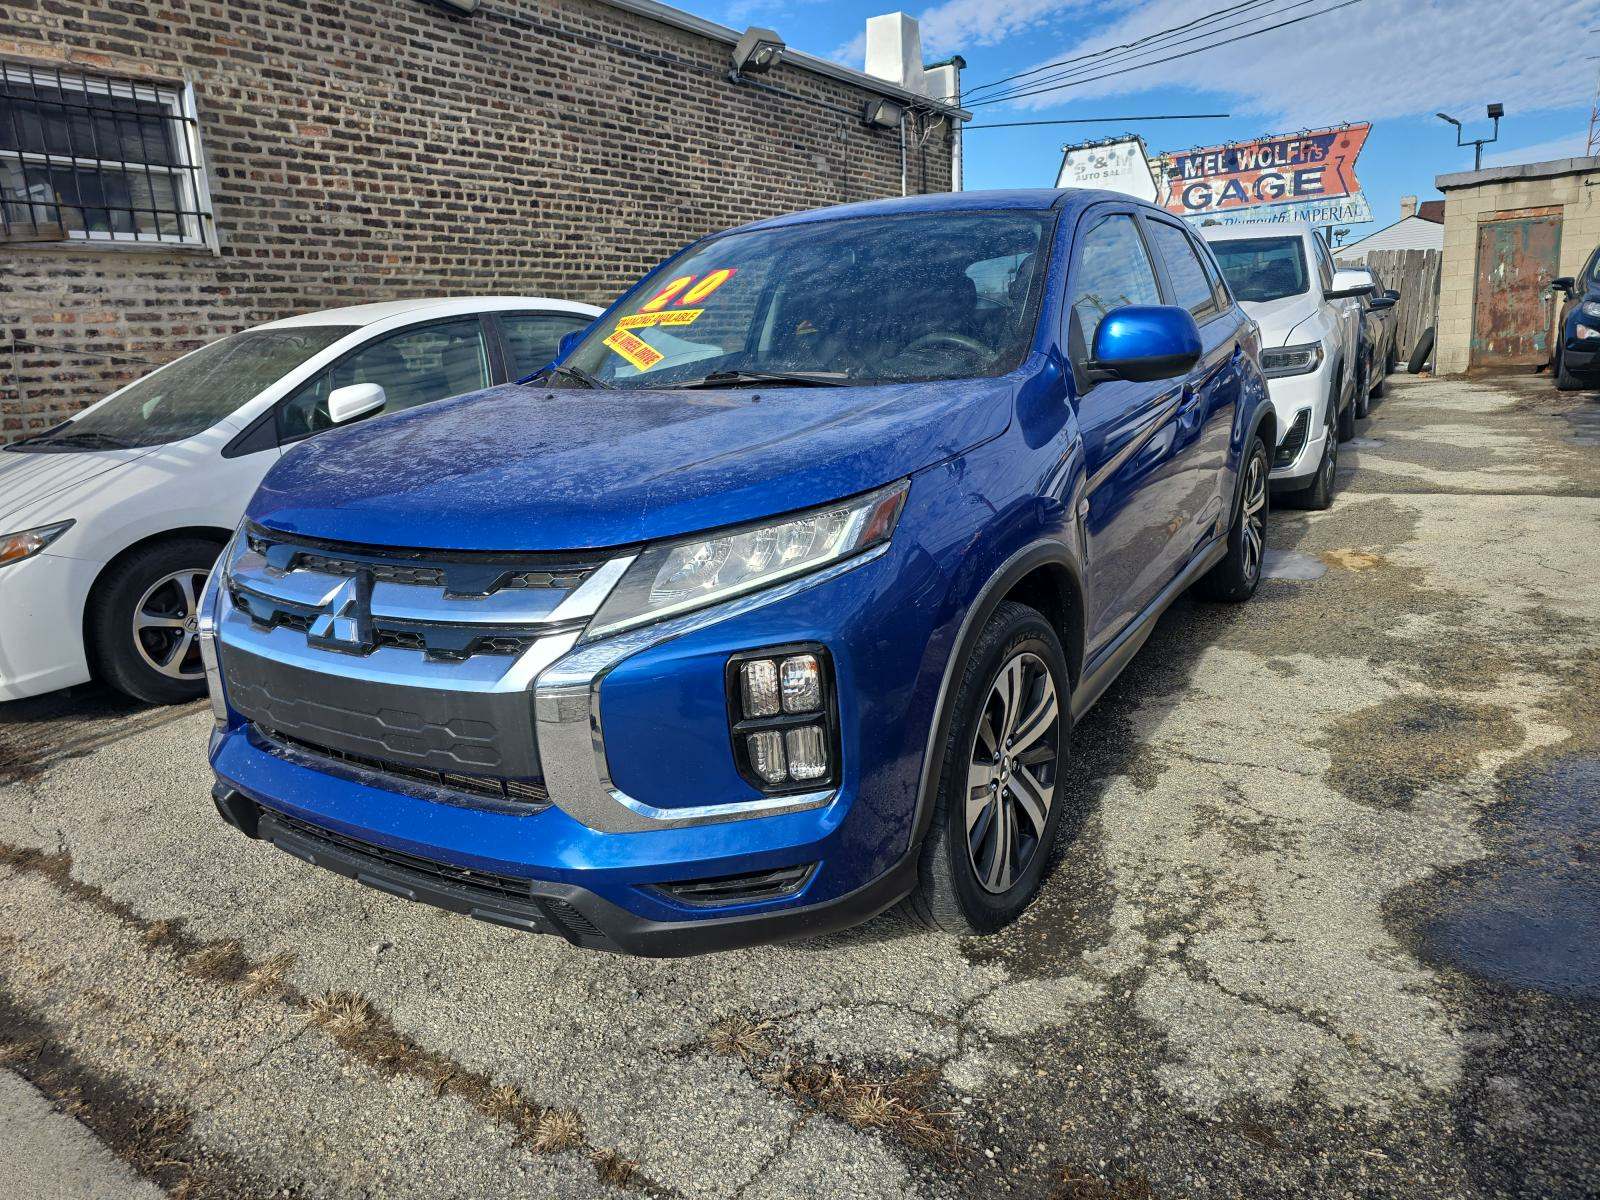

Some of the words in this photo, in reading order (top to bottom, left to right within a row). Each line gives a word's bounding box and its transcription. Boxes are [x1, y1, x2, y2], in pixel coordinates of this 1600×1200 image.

[1094, 156, 1108, 169] &
[1184, 152, 1229, 179] MEL
[1076, 171, 1100, 182] AUTO
[1294, 204, 1361, 222] IMPERIAL
[639, 269, 736, 312] 20
[619, 335, 642, 354] WHEEL
[634, 347, 660, 366] DRIVE
